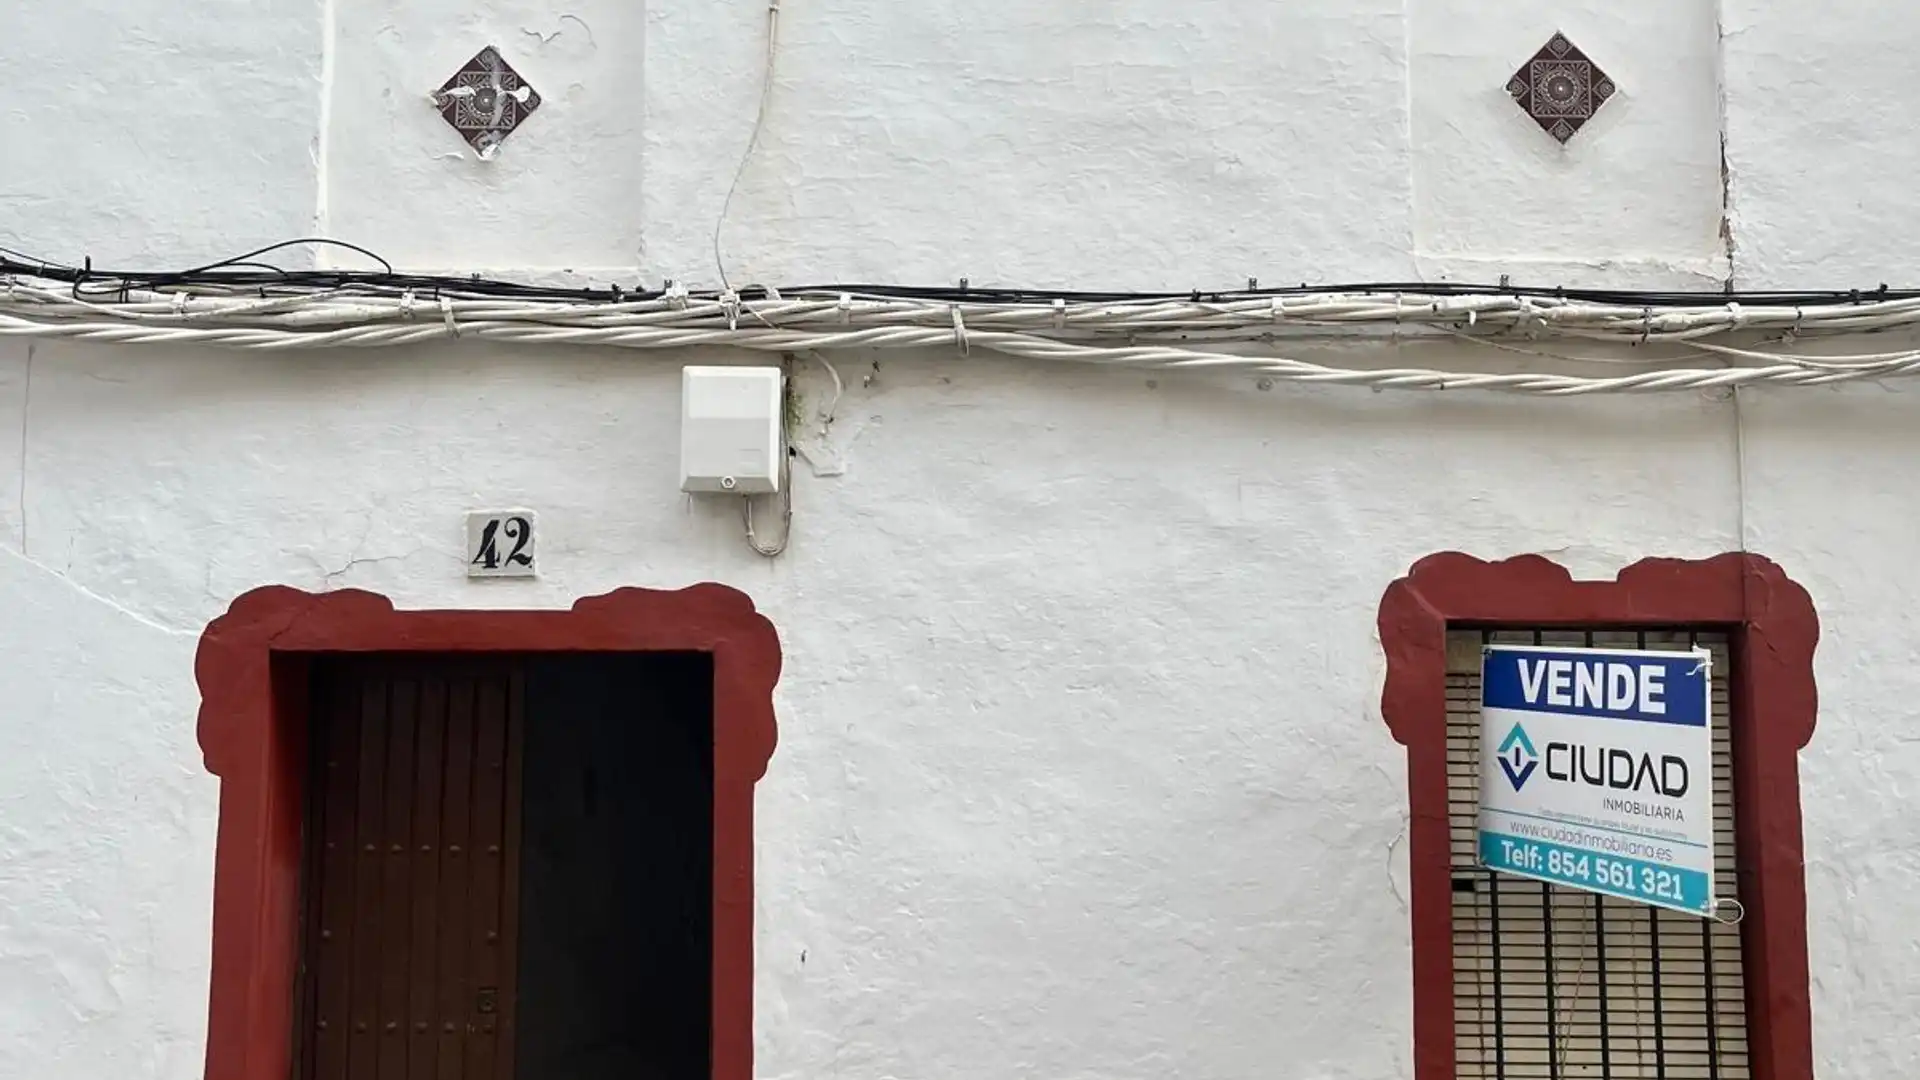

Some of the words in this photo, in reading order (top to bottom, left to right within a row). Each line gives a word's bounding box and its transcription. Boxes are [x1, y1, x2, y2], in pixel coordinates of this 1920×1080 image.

[471, 516, 532, 568] 42
[1517, 658, 1666, 714] VENDE
[1546, 742, 1688, 797] CIUDAD
[1603, 798, 1685, 822] INMOBILIARIA
[1510, 820, 1673, 861] www.ciudadinmobiliaria.es
[1501, 840, 1543, 870] Telf:
[1548, 849, 1590, 880] 854
[1596, 860, 1636, 890] 561
[1641, 870, 1684, 900] 321
